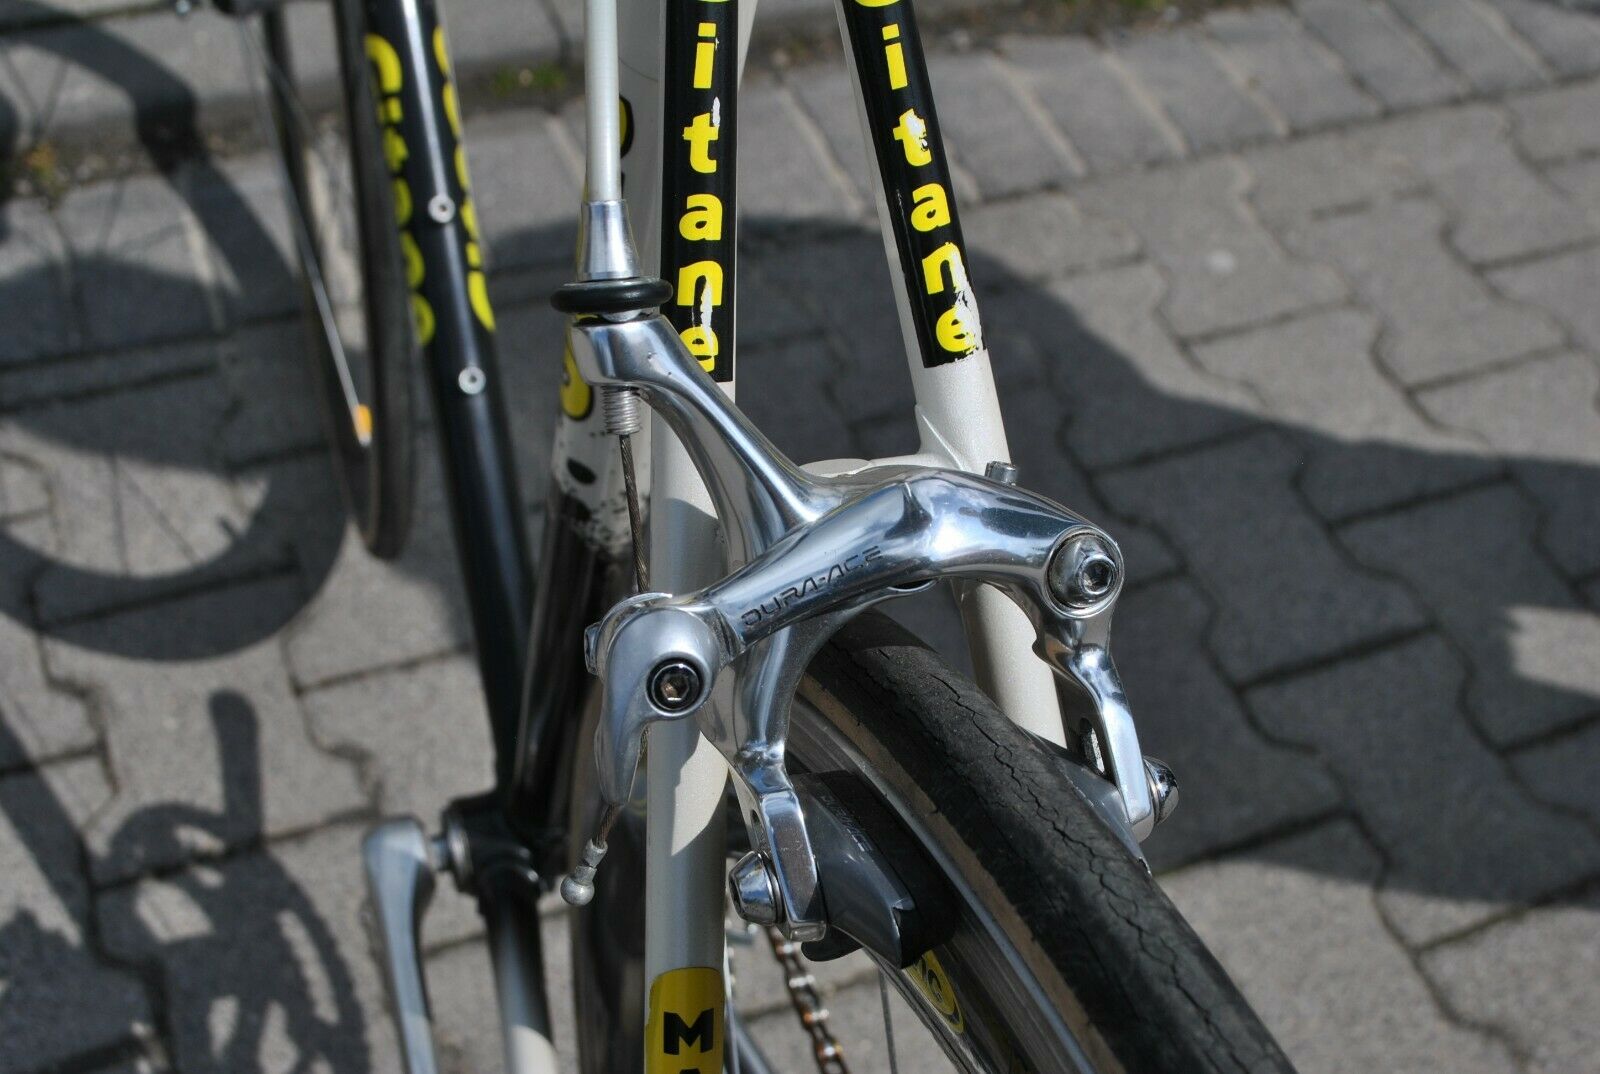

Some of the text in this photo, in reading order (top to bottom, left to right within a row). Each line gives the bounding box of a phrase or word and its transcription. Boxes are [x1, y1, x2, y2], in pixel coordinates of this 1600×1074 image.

[677, 0, 724, 372] itane
[855, 0, 980, 353] itane
[741, 545, 883, 626] DURA-ACE
